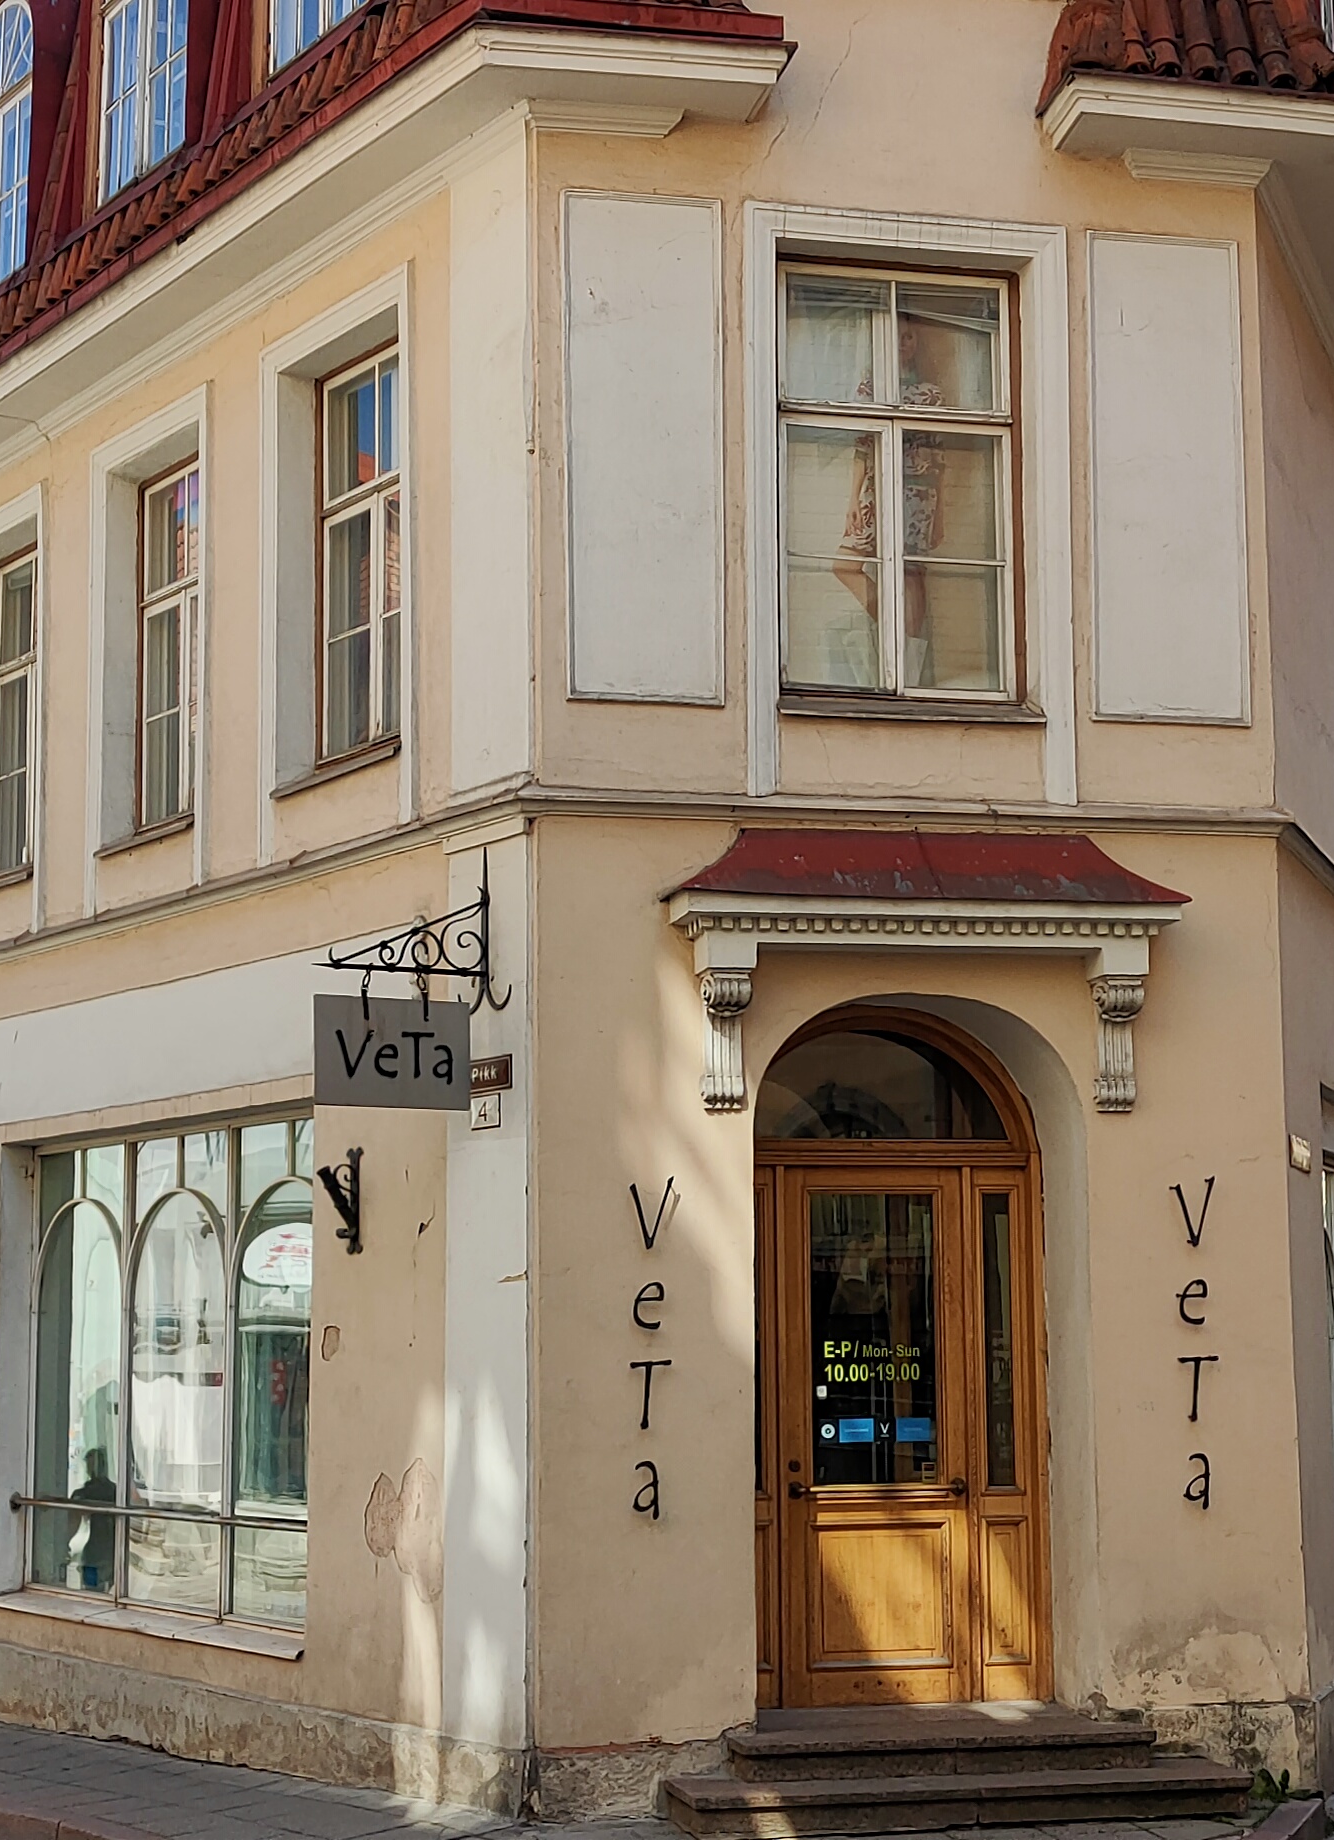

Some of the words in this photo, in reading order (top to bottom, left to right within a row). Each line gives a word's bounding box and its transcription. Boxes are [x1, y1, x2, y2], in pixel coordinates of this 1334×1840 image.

[335, 1029, 454, 1085] VeTa
[471, 1066, 499, 1083] Pikk
[478, 1101, 488, 1122] 4
[824, 1363, 920, 1382] 10.00-19.00
